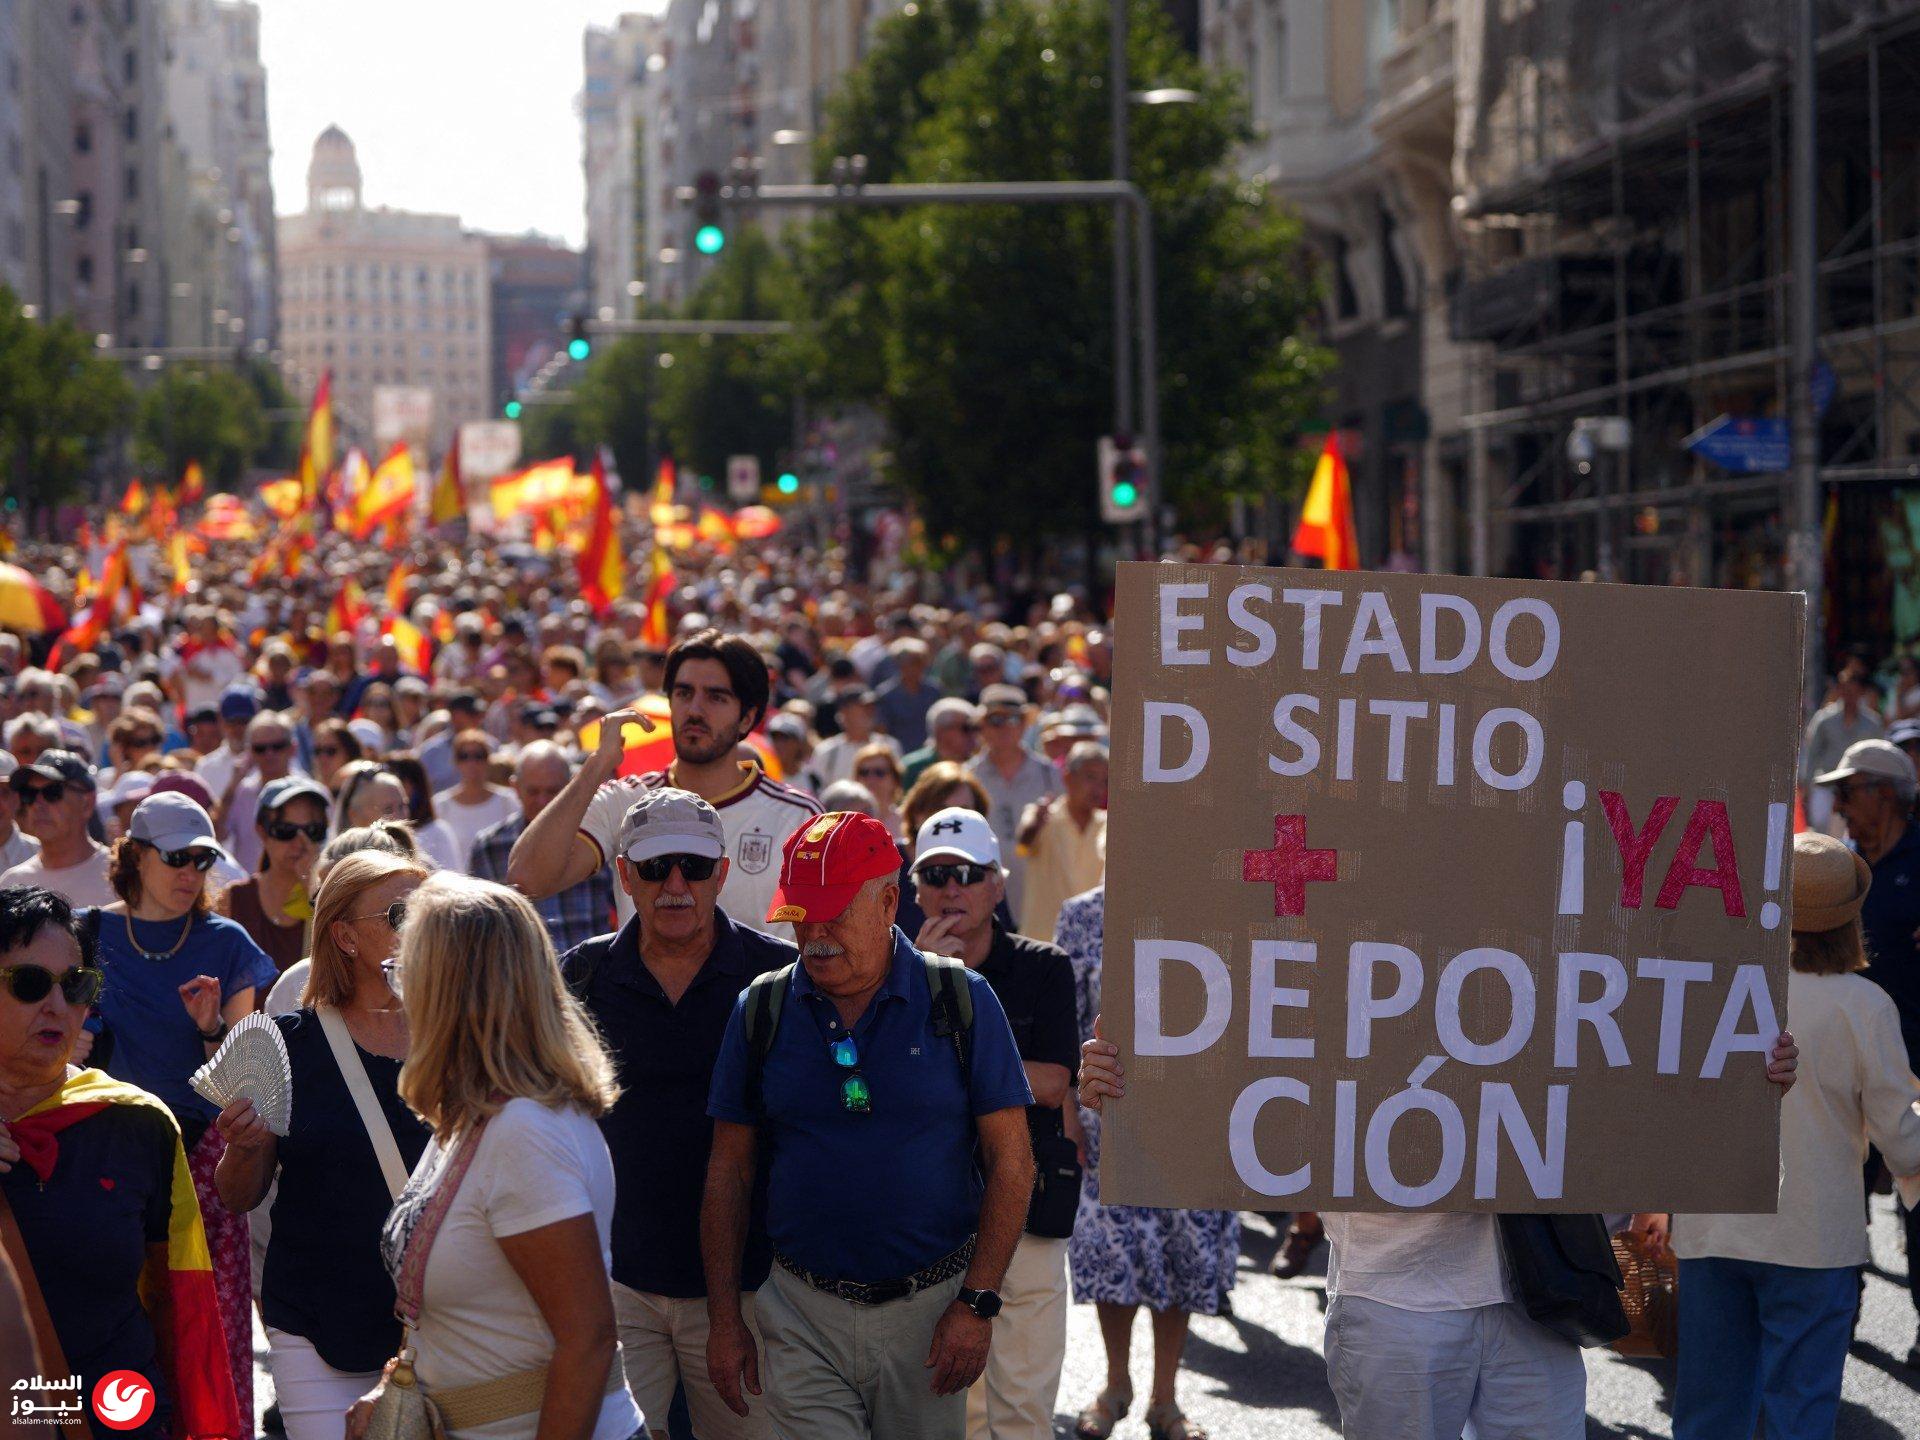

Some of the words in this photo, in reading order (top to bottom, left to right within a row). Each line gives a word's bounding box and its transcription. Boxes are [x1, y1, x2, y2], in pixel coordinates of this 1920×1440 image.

[1158, 582, 1562, 682] ESTADO
[1141, 700, 1211, 784] D
[1267, 692, 1546, 792] SITIO
[1227, 1055, 1570, 1208] CIÓN
